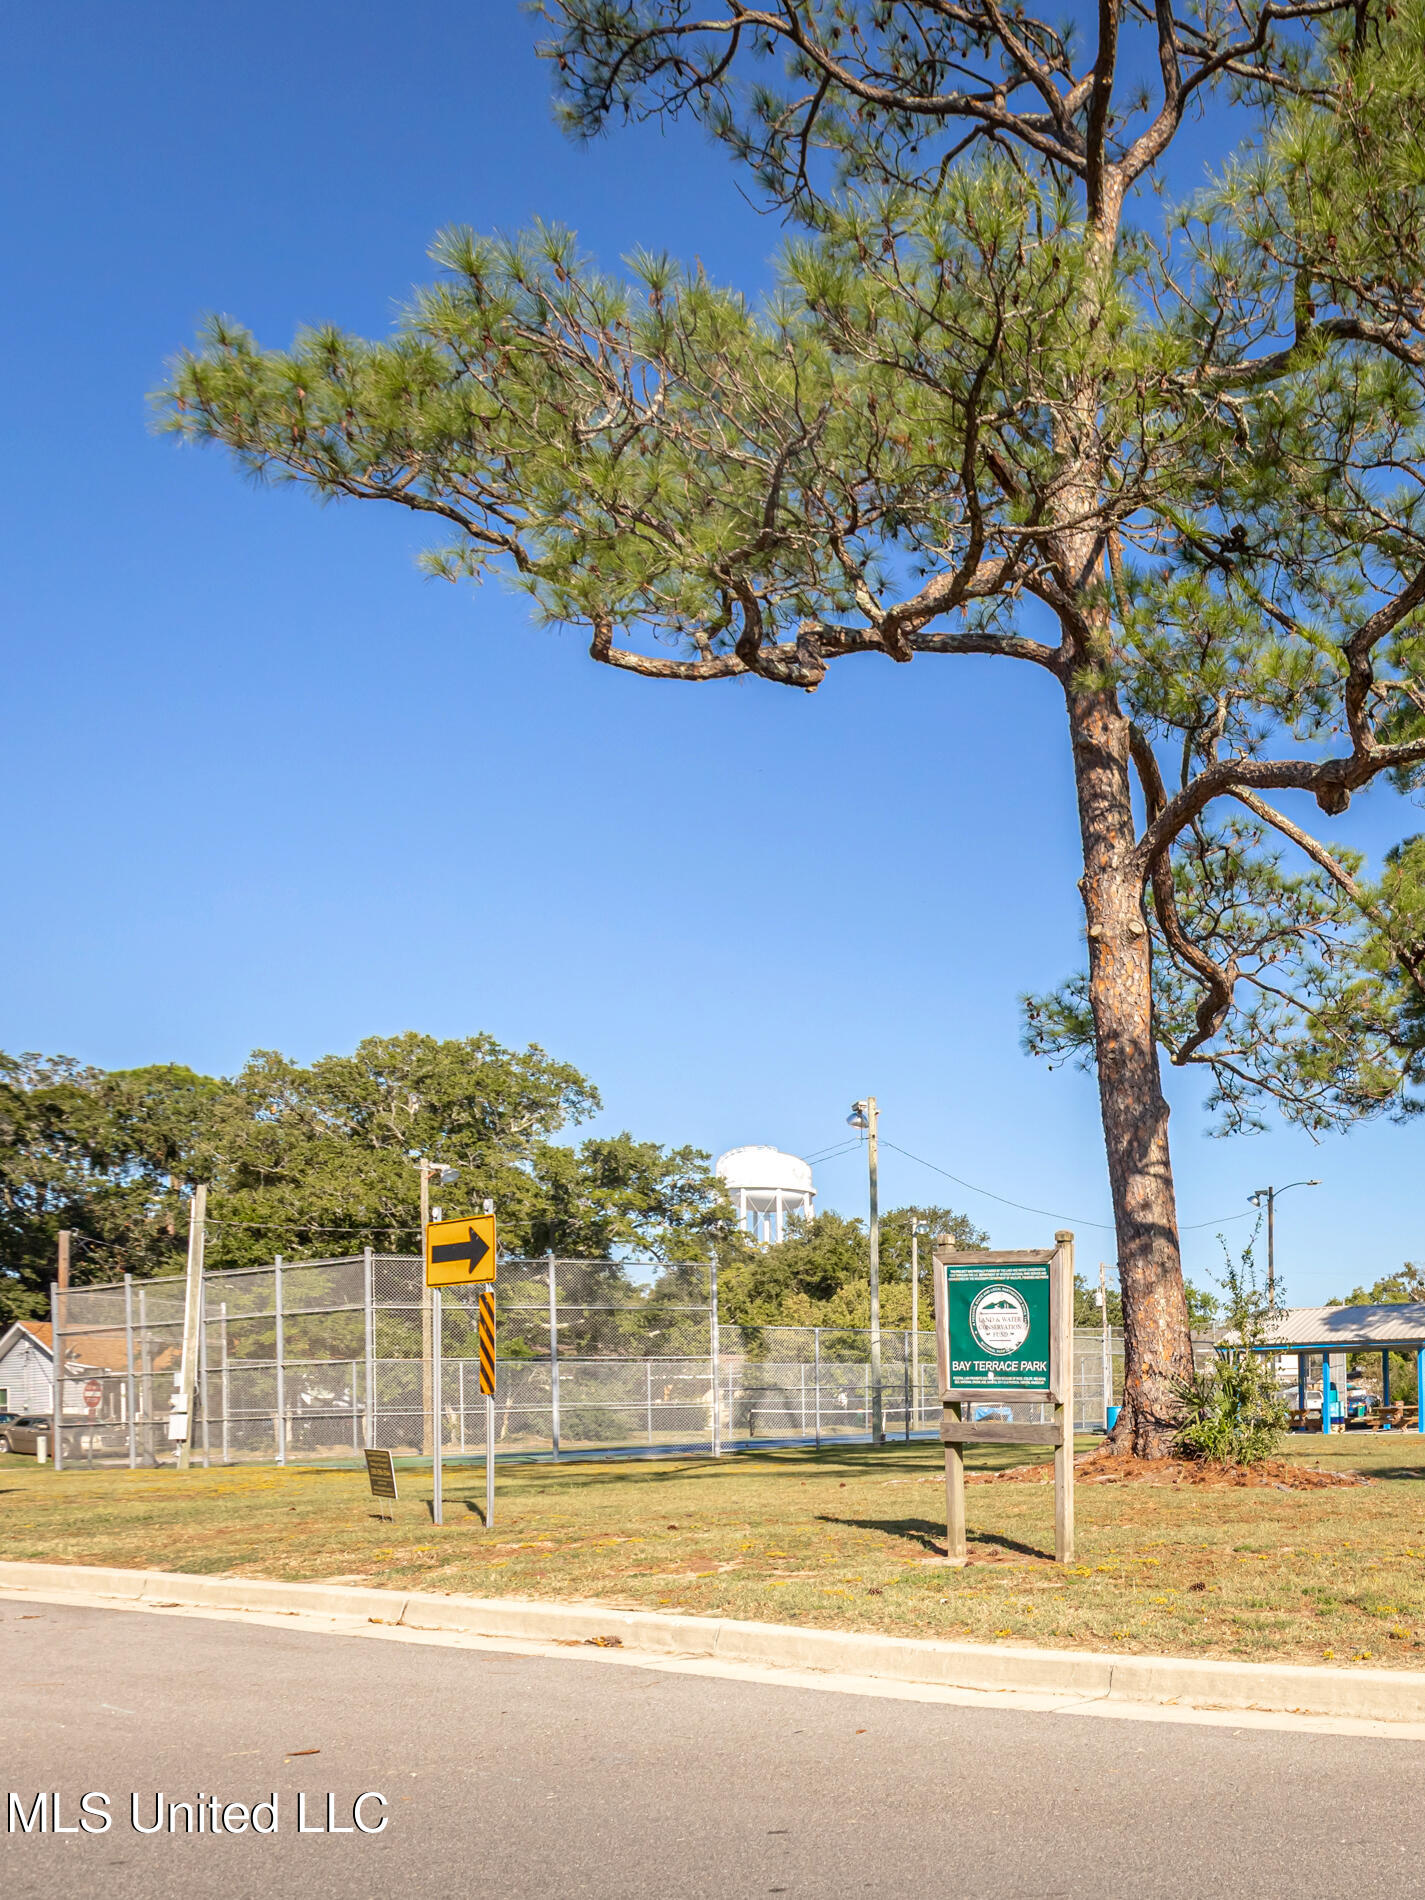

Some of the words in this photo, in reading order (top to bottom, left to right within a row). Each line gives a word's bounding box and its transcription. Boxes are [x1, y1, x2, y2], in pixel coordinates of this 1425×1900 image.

[952, 1361, 972, 1371] BAY
[973, 1360, 1019, 1371] TERRACE
[1020, 1360, 1047, 1371] PARK
